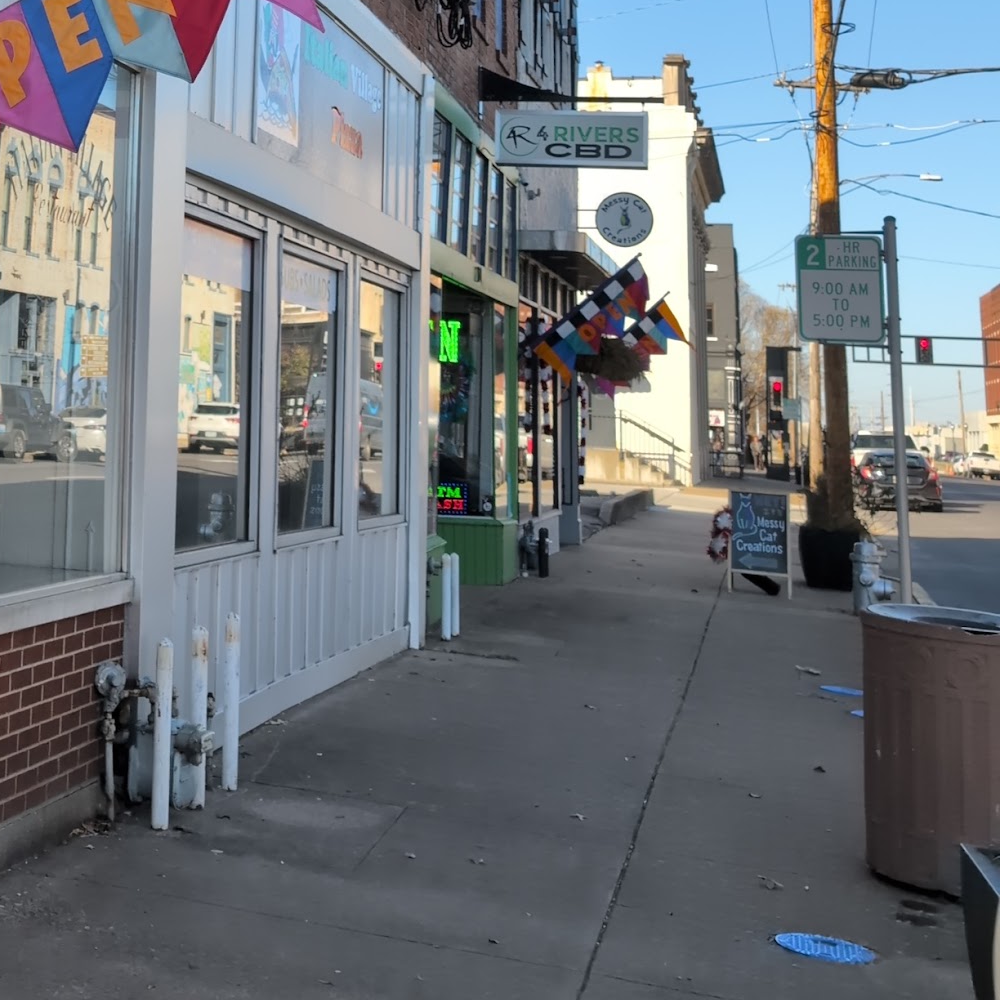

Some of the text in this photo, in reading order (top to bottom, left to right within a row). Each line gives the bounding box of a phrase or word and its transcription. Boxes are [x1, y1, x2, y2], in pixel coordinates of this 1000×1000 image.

[350, 63, 382, 113] Village
[554, 126, 639, 143] RIVERS
[545, 143, 632, 159] CBD
[602, 197, 629, 213] Messy
[602, 226, 647, 244] Creations
[806, 241, 860, 266] 2 HR
[828, 255, 877, 268] PARKING
[812, 281, 869, 296] 9:00 AM
[832, 298, 849, 311] TO
[813, 313, 870, 328] 5:00 PM
[757, 517, 785, 532] Messy
[759, 529, 777, 541] Cat
[736, 539, 783, 554] Creations
